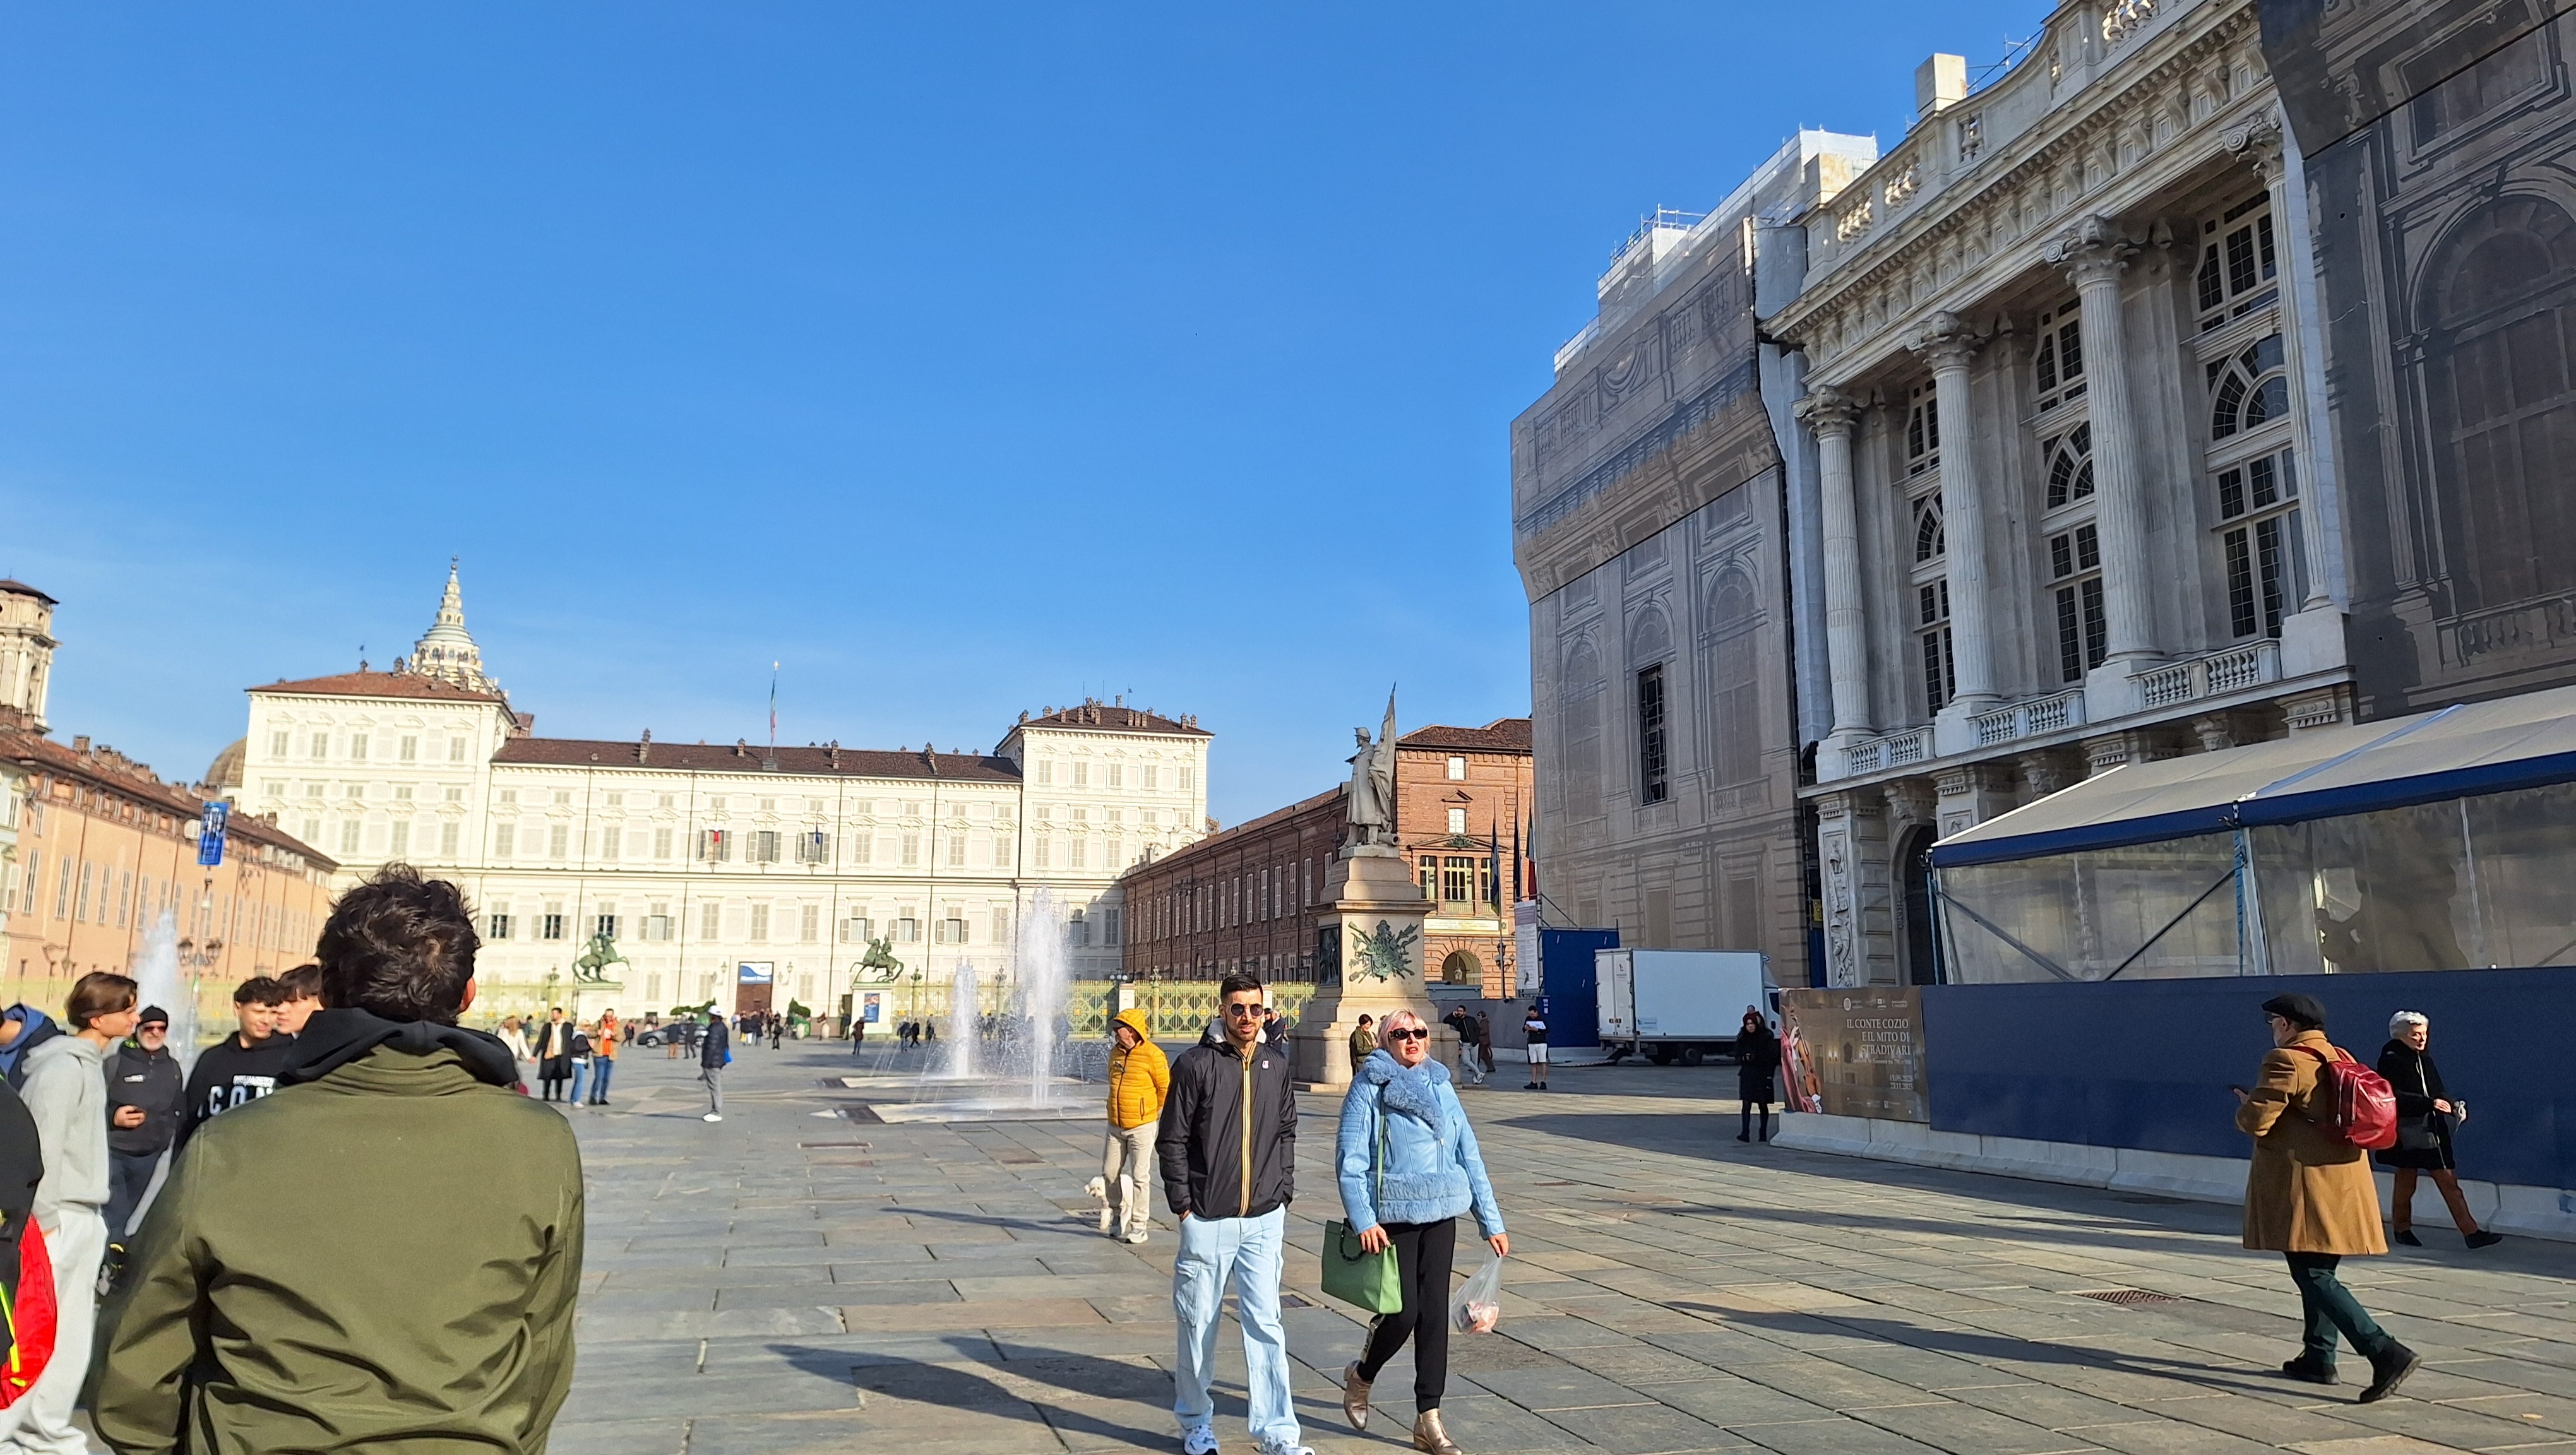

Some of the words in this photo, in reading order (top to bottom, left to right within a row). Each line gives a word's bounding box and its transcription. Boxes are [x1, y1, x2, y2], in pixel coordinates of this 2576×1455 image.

[1846, 1019, 1854, 1028] IL
[1854, 1018, 1881, 1028] CONTE
[1882, 1018, 1909, 1028] COZIO
[1862, 1031, 1866, 1042] E
[1868, 1031, 1875, 1042] IL
[1876, 1031, 1898, 1042] MITO
[1900, 1031, 1909, 1042] DI
[1861, 1045, 1911, 1055] STRADIVARI
